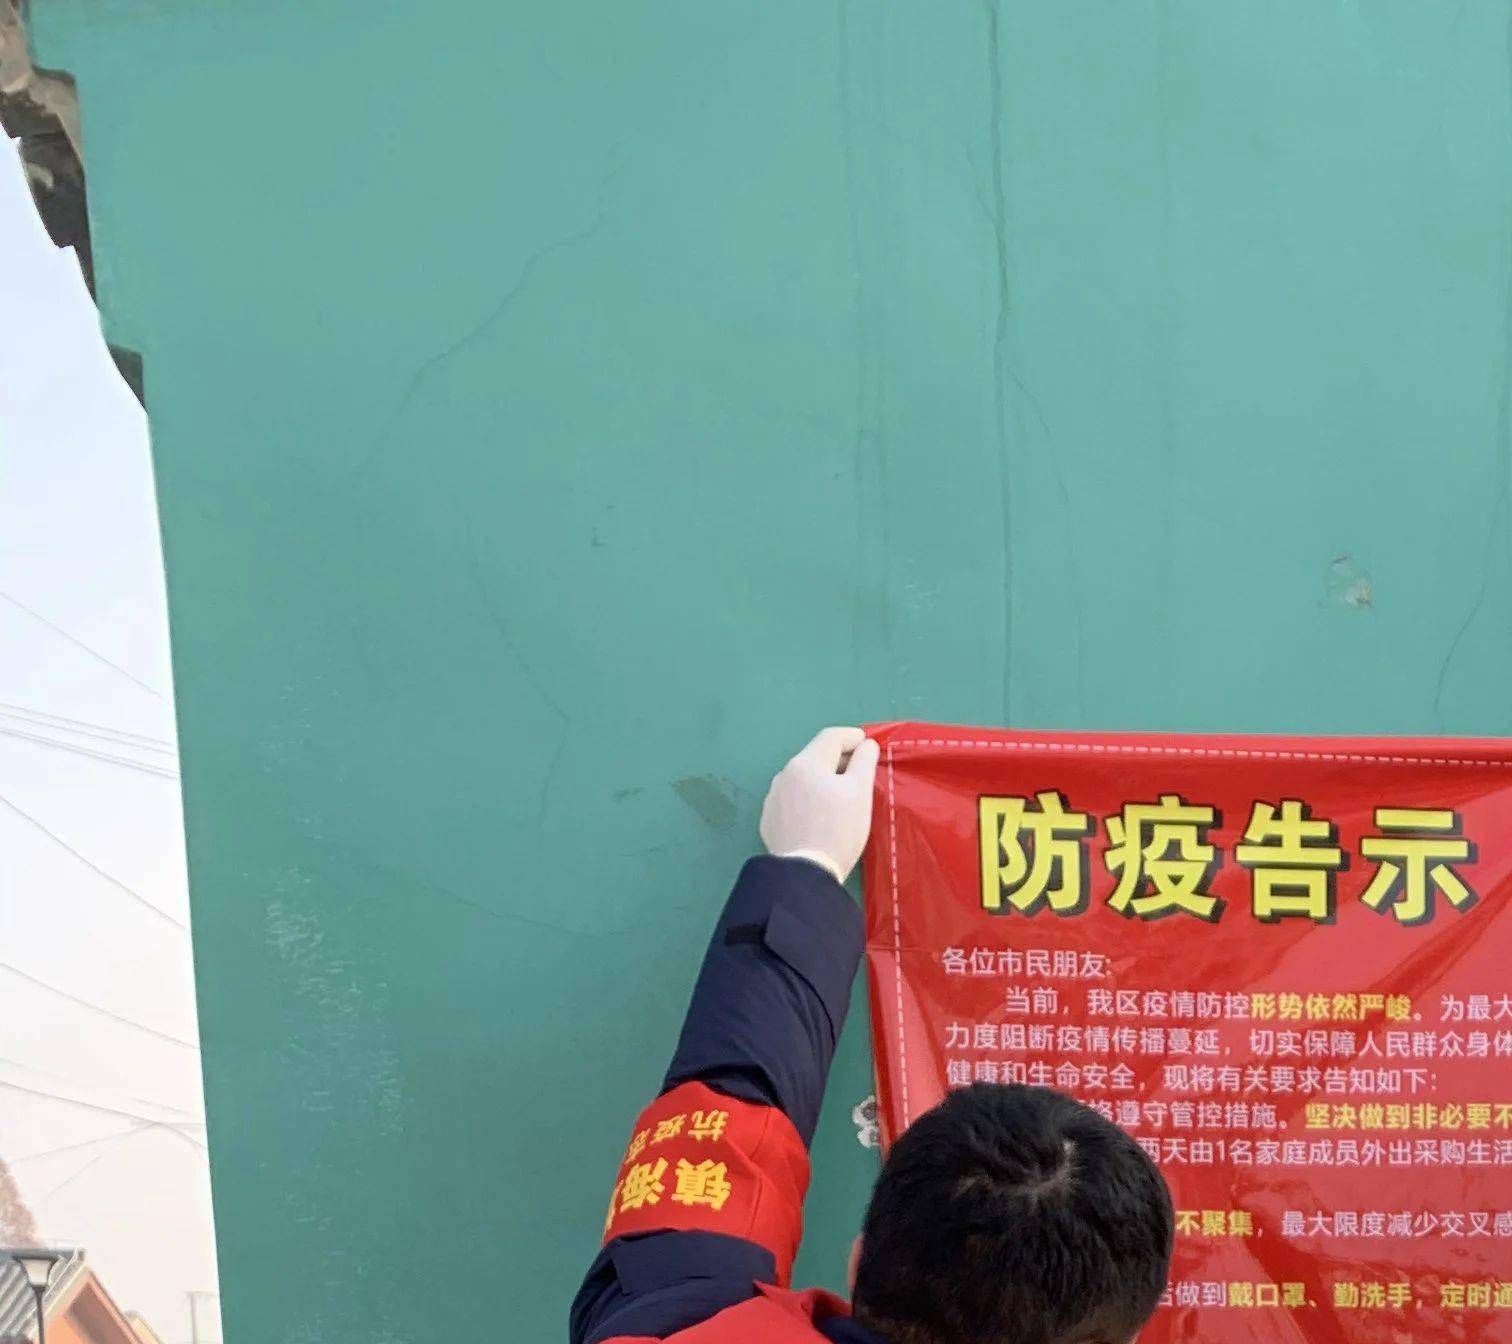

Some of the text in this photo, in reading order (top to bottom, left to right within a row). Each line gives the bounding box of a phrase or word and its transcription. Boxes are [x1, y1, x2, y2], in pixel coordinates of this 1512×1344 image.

[977, 791, 1475, 924] 防疫告示
[942, 946, 1112, 978] 各位市民朋友：
[604, 1157, 731, 1233] 镇海
